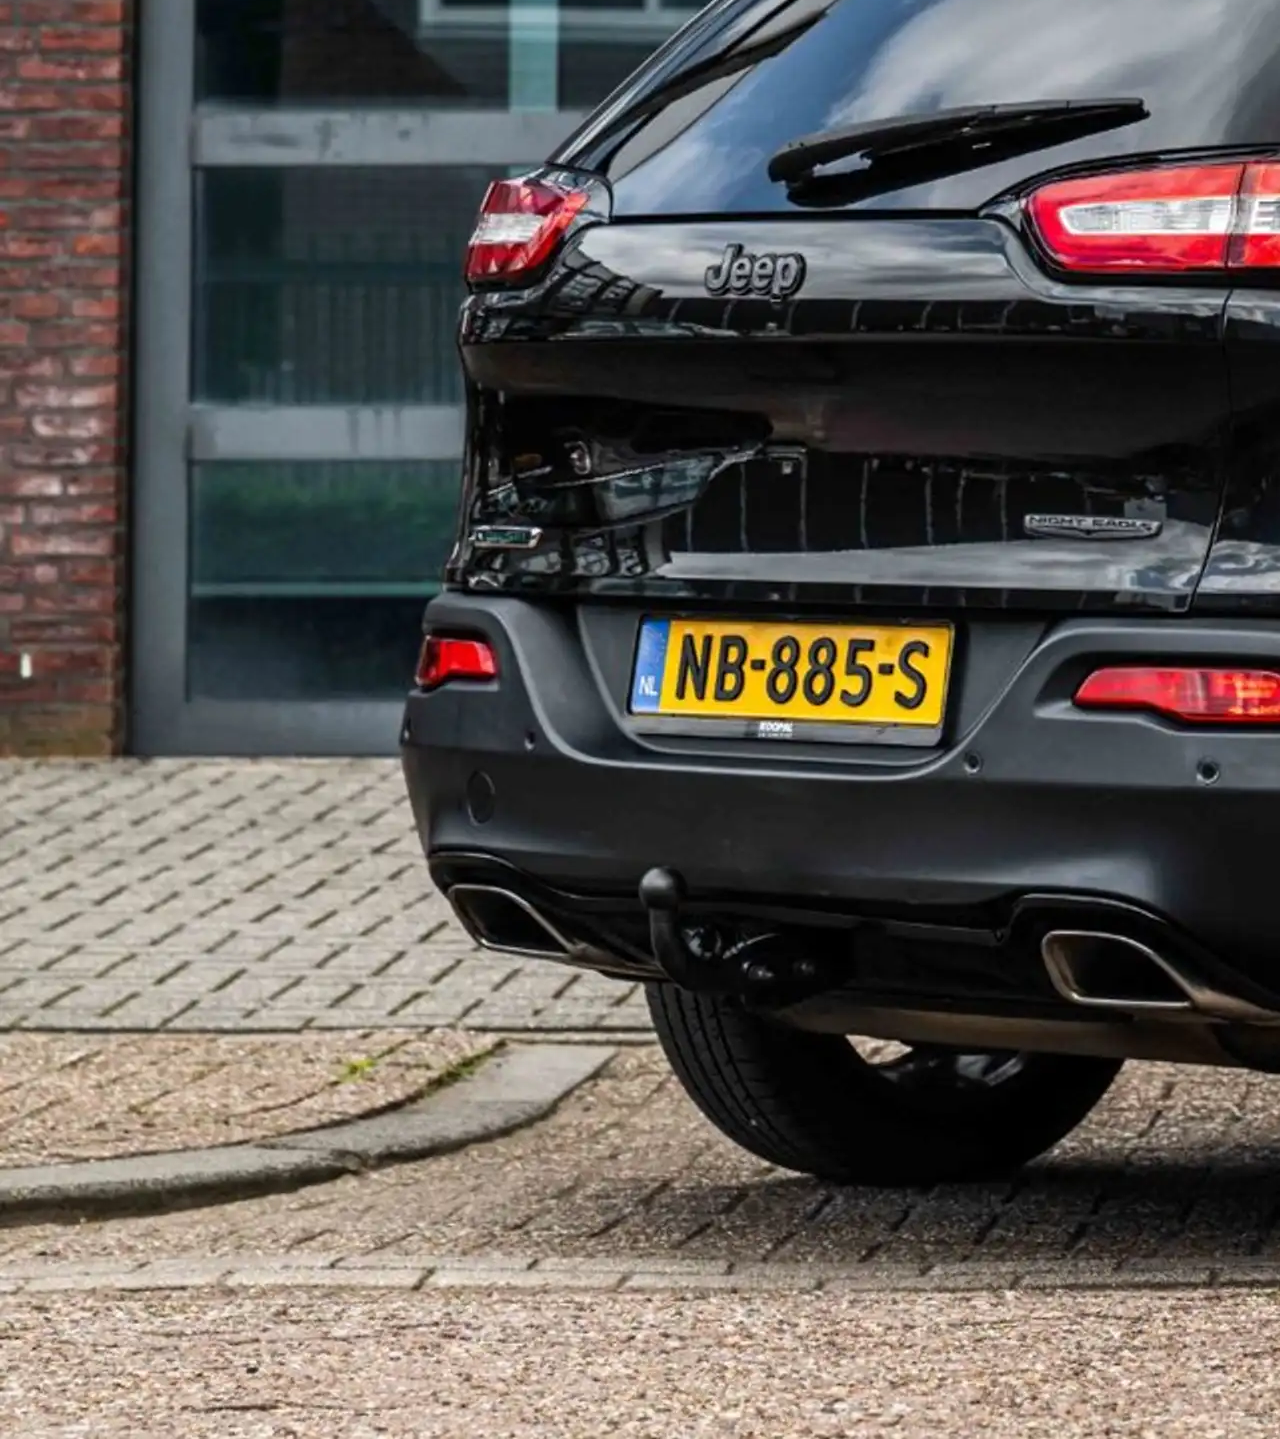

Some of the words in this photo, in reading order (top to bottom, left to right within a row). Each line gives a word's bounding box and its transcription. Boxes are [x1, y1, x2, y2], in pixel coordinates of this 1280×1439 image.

[704, 243, 806, 301] Jeep
[638, 675, 658, 696] NL
[676, 633, 930, 709] NB-885-S
